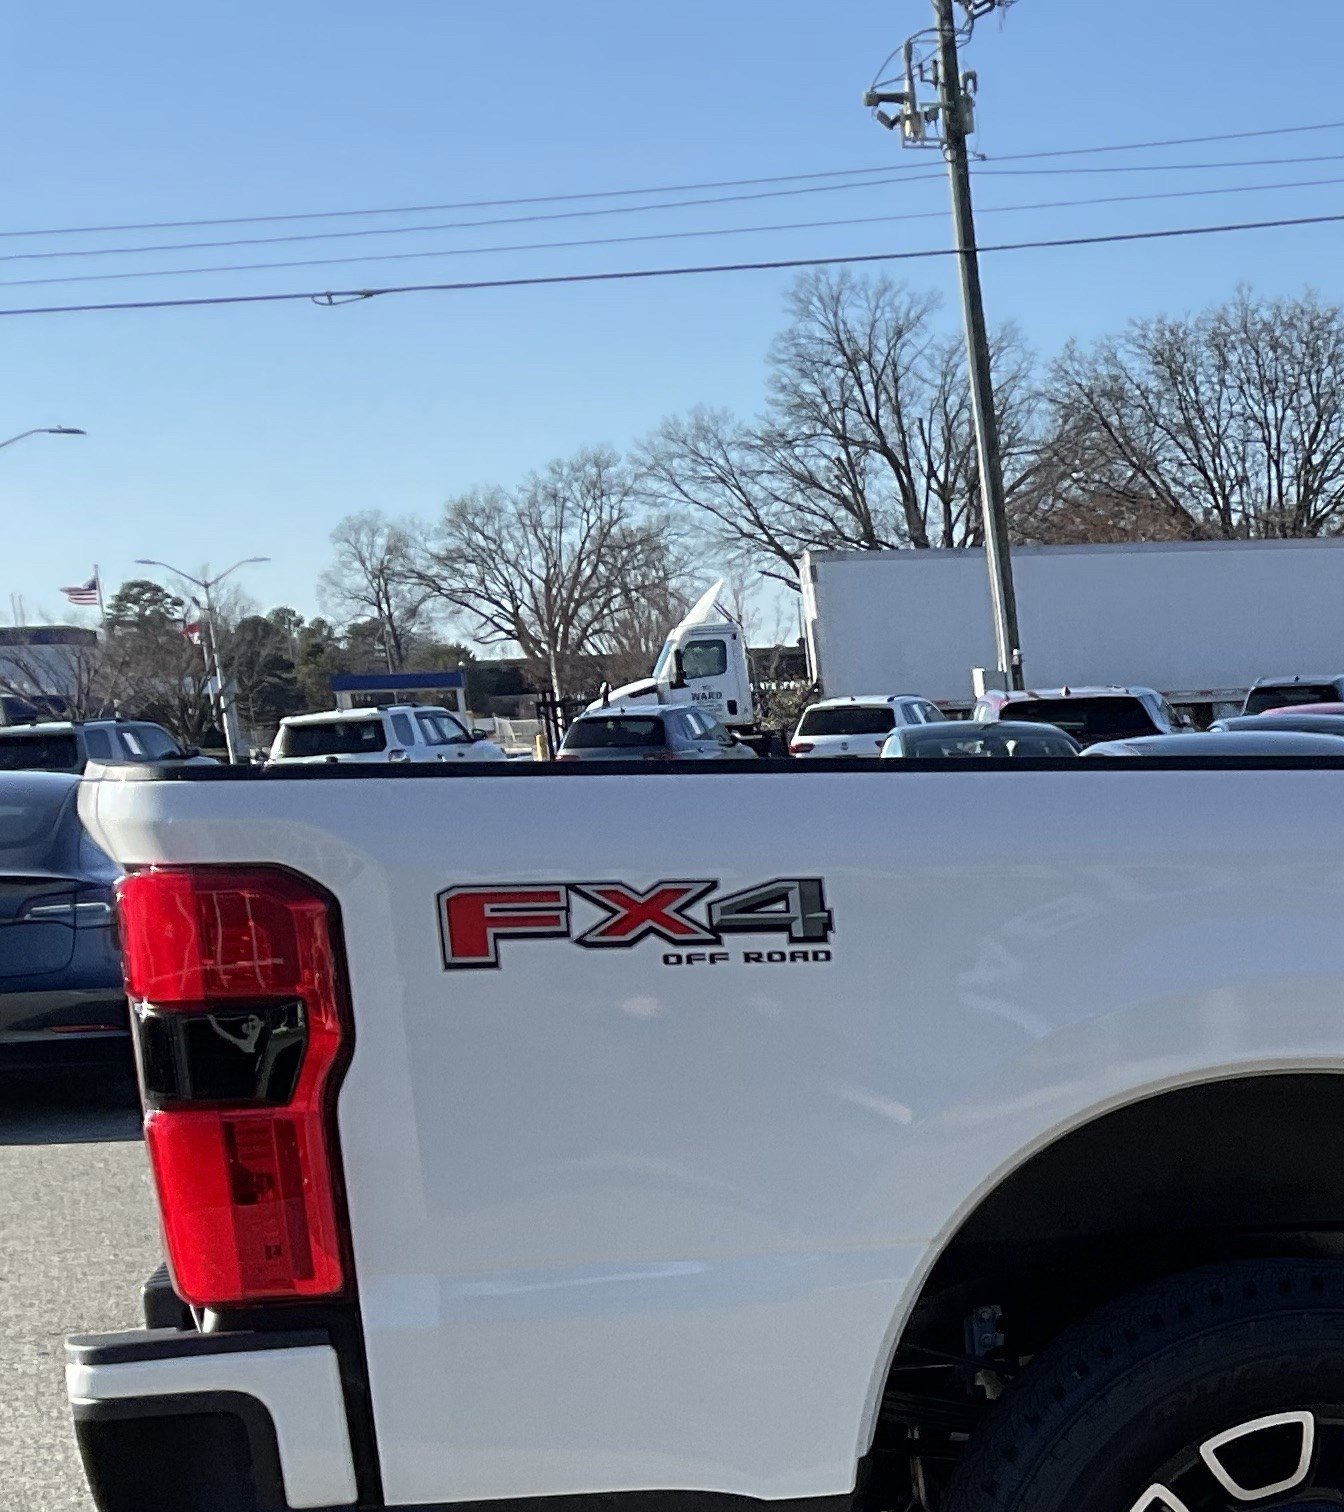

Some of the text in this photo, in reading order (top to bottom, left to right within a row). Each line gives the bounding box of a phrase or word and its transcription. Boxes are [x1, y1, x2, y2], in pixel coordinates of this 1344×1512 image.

[691, 691, 723, 701] WARD
[437, 877, 836, 971] FX4
[662, 949, 832, 966] OFF ROAD
